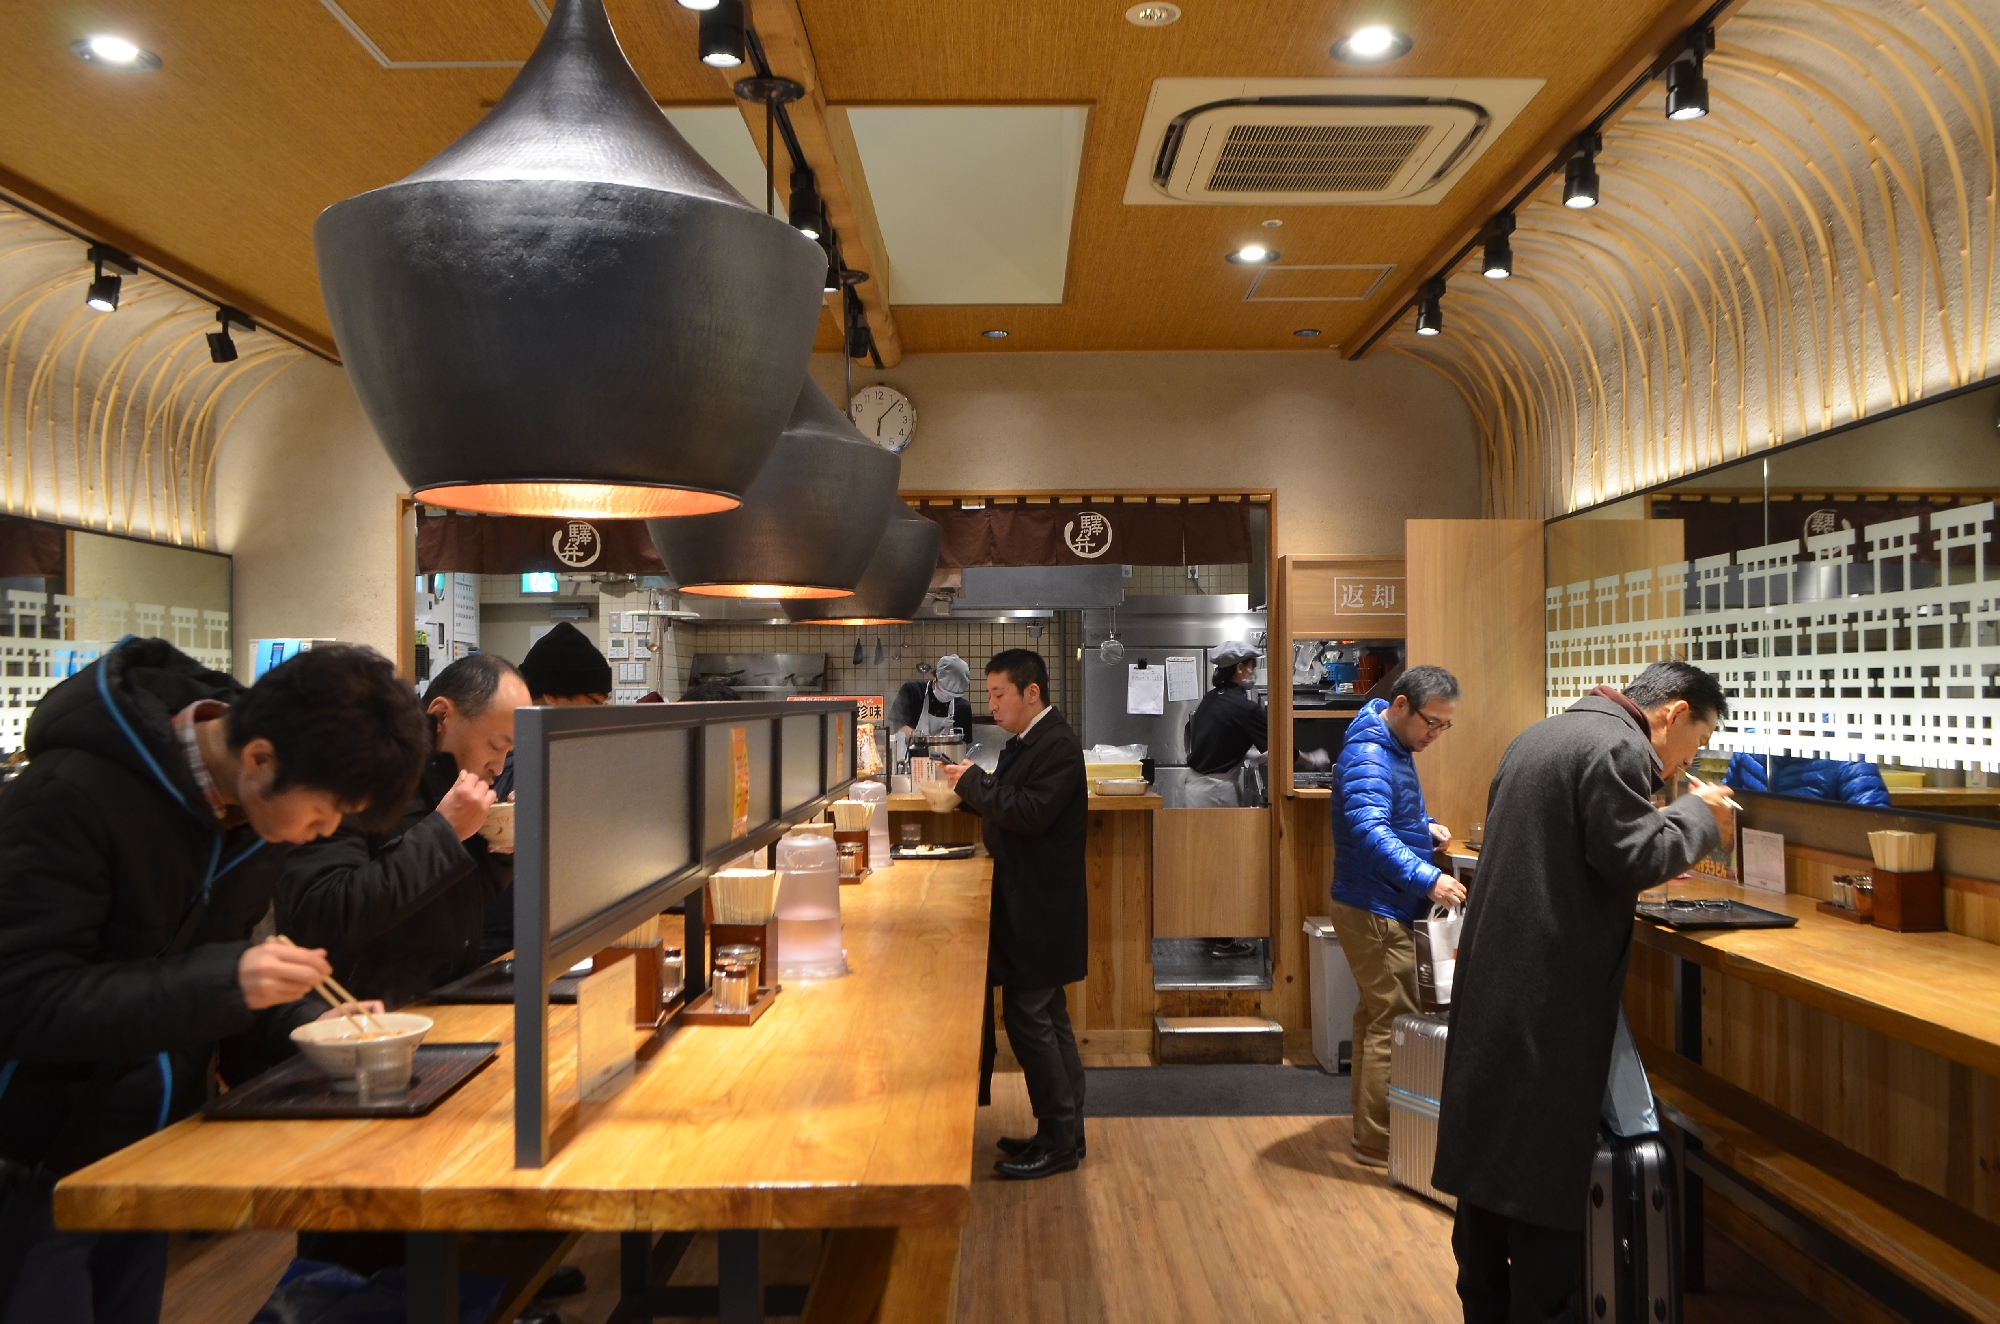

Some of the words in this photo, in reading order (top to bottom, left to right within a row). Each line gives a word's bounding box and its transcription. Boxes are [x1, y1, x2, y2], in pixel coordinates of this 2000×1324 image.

[864, 394, 871, 404] 11
[875, 391, 884, 401] 12
[855, 403, 863, 413] 10
[898, 403, 904, 413] 2
[902, 416, 908, 425] 3
[898, 428, 904, 437] 4
[888, 437, 895, 446] 5
[1340, 584, 1396, 609] 返却
[857, 704, 882, 720] 珍味
